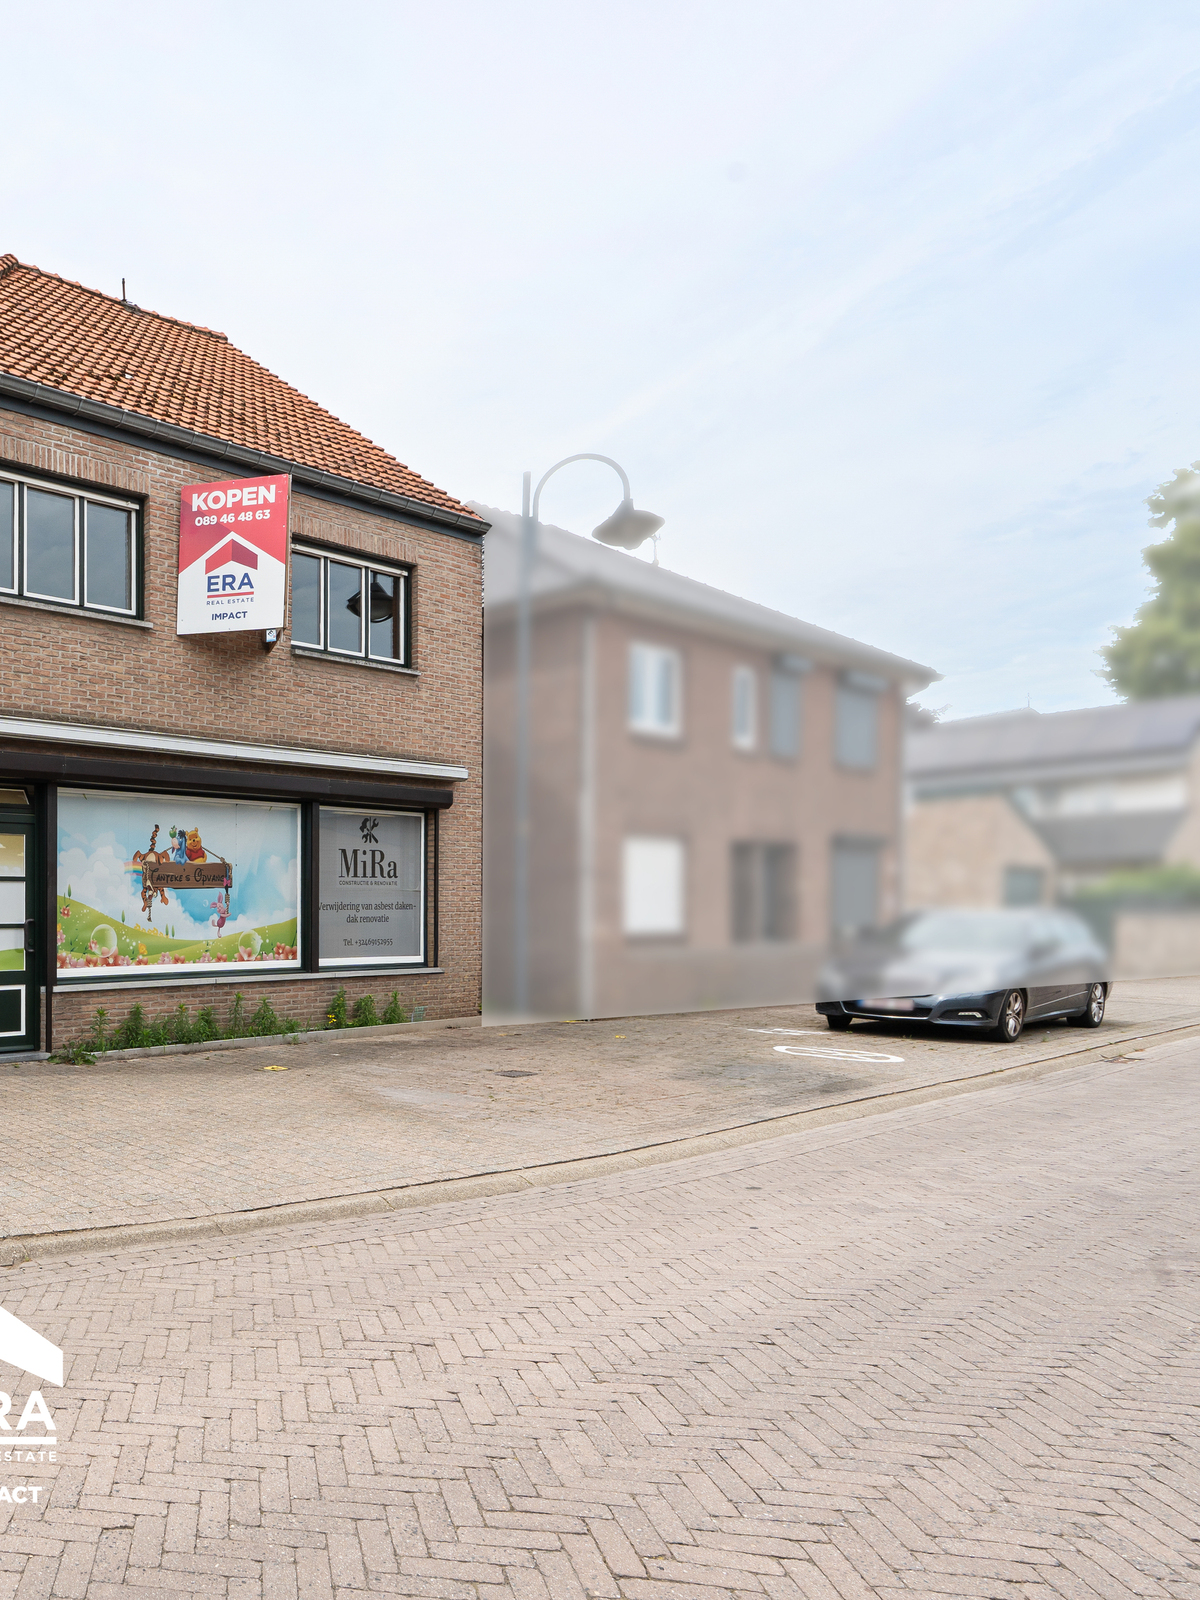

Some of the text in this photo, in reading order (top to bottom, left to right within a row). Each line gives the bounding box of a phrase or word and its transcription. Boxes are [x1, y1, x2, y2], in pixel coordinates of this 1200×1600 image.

[192, 485, 276, 512] KOPEN
[195, 509, 271, 527] 089 46 48 63
[207, 572, 254, 592] ERA
[227, 597, 255, 605] ESTATE
[211, 611, 248, 621] IMPACT
[338, 848, 399, 879] MiRa
[361, 903, 373, 911] van
[374, 901, 394, 911] asbest
[394, 901, 416, 911] daken-
[346, 914, 390, 924] dak renovatie
[343, 938, 354, 946] Tel.
